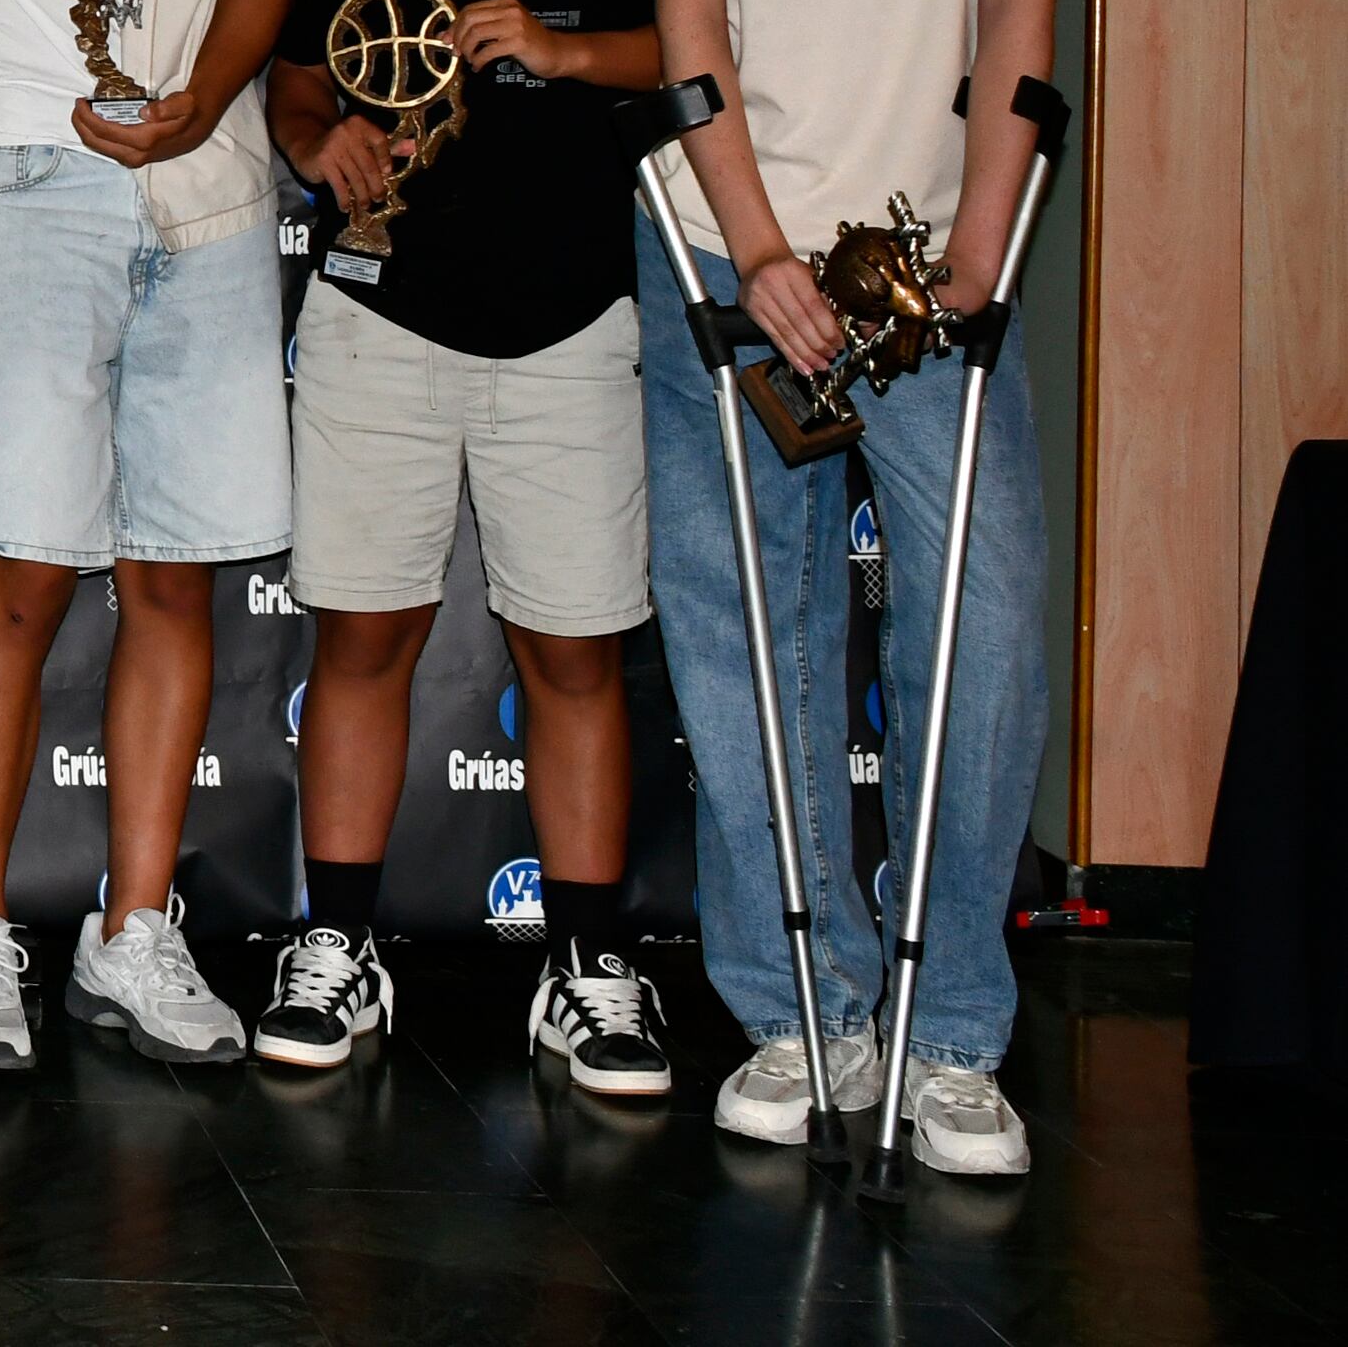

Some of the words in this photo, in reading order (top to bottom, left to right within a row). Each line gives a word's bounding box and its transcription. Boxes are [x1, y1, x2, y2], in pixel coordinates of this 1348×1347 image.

[52, 745, 108, 788] Grúa
[448, 749, 526, 791] Grúas
[505, 870, 526, 896] V
